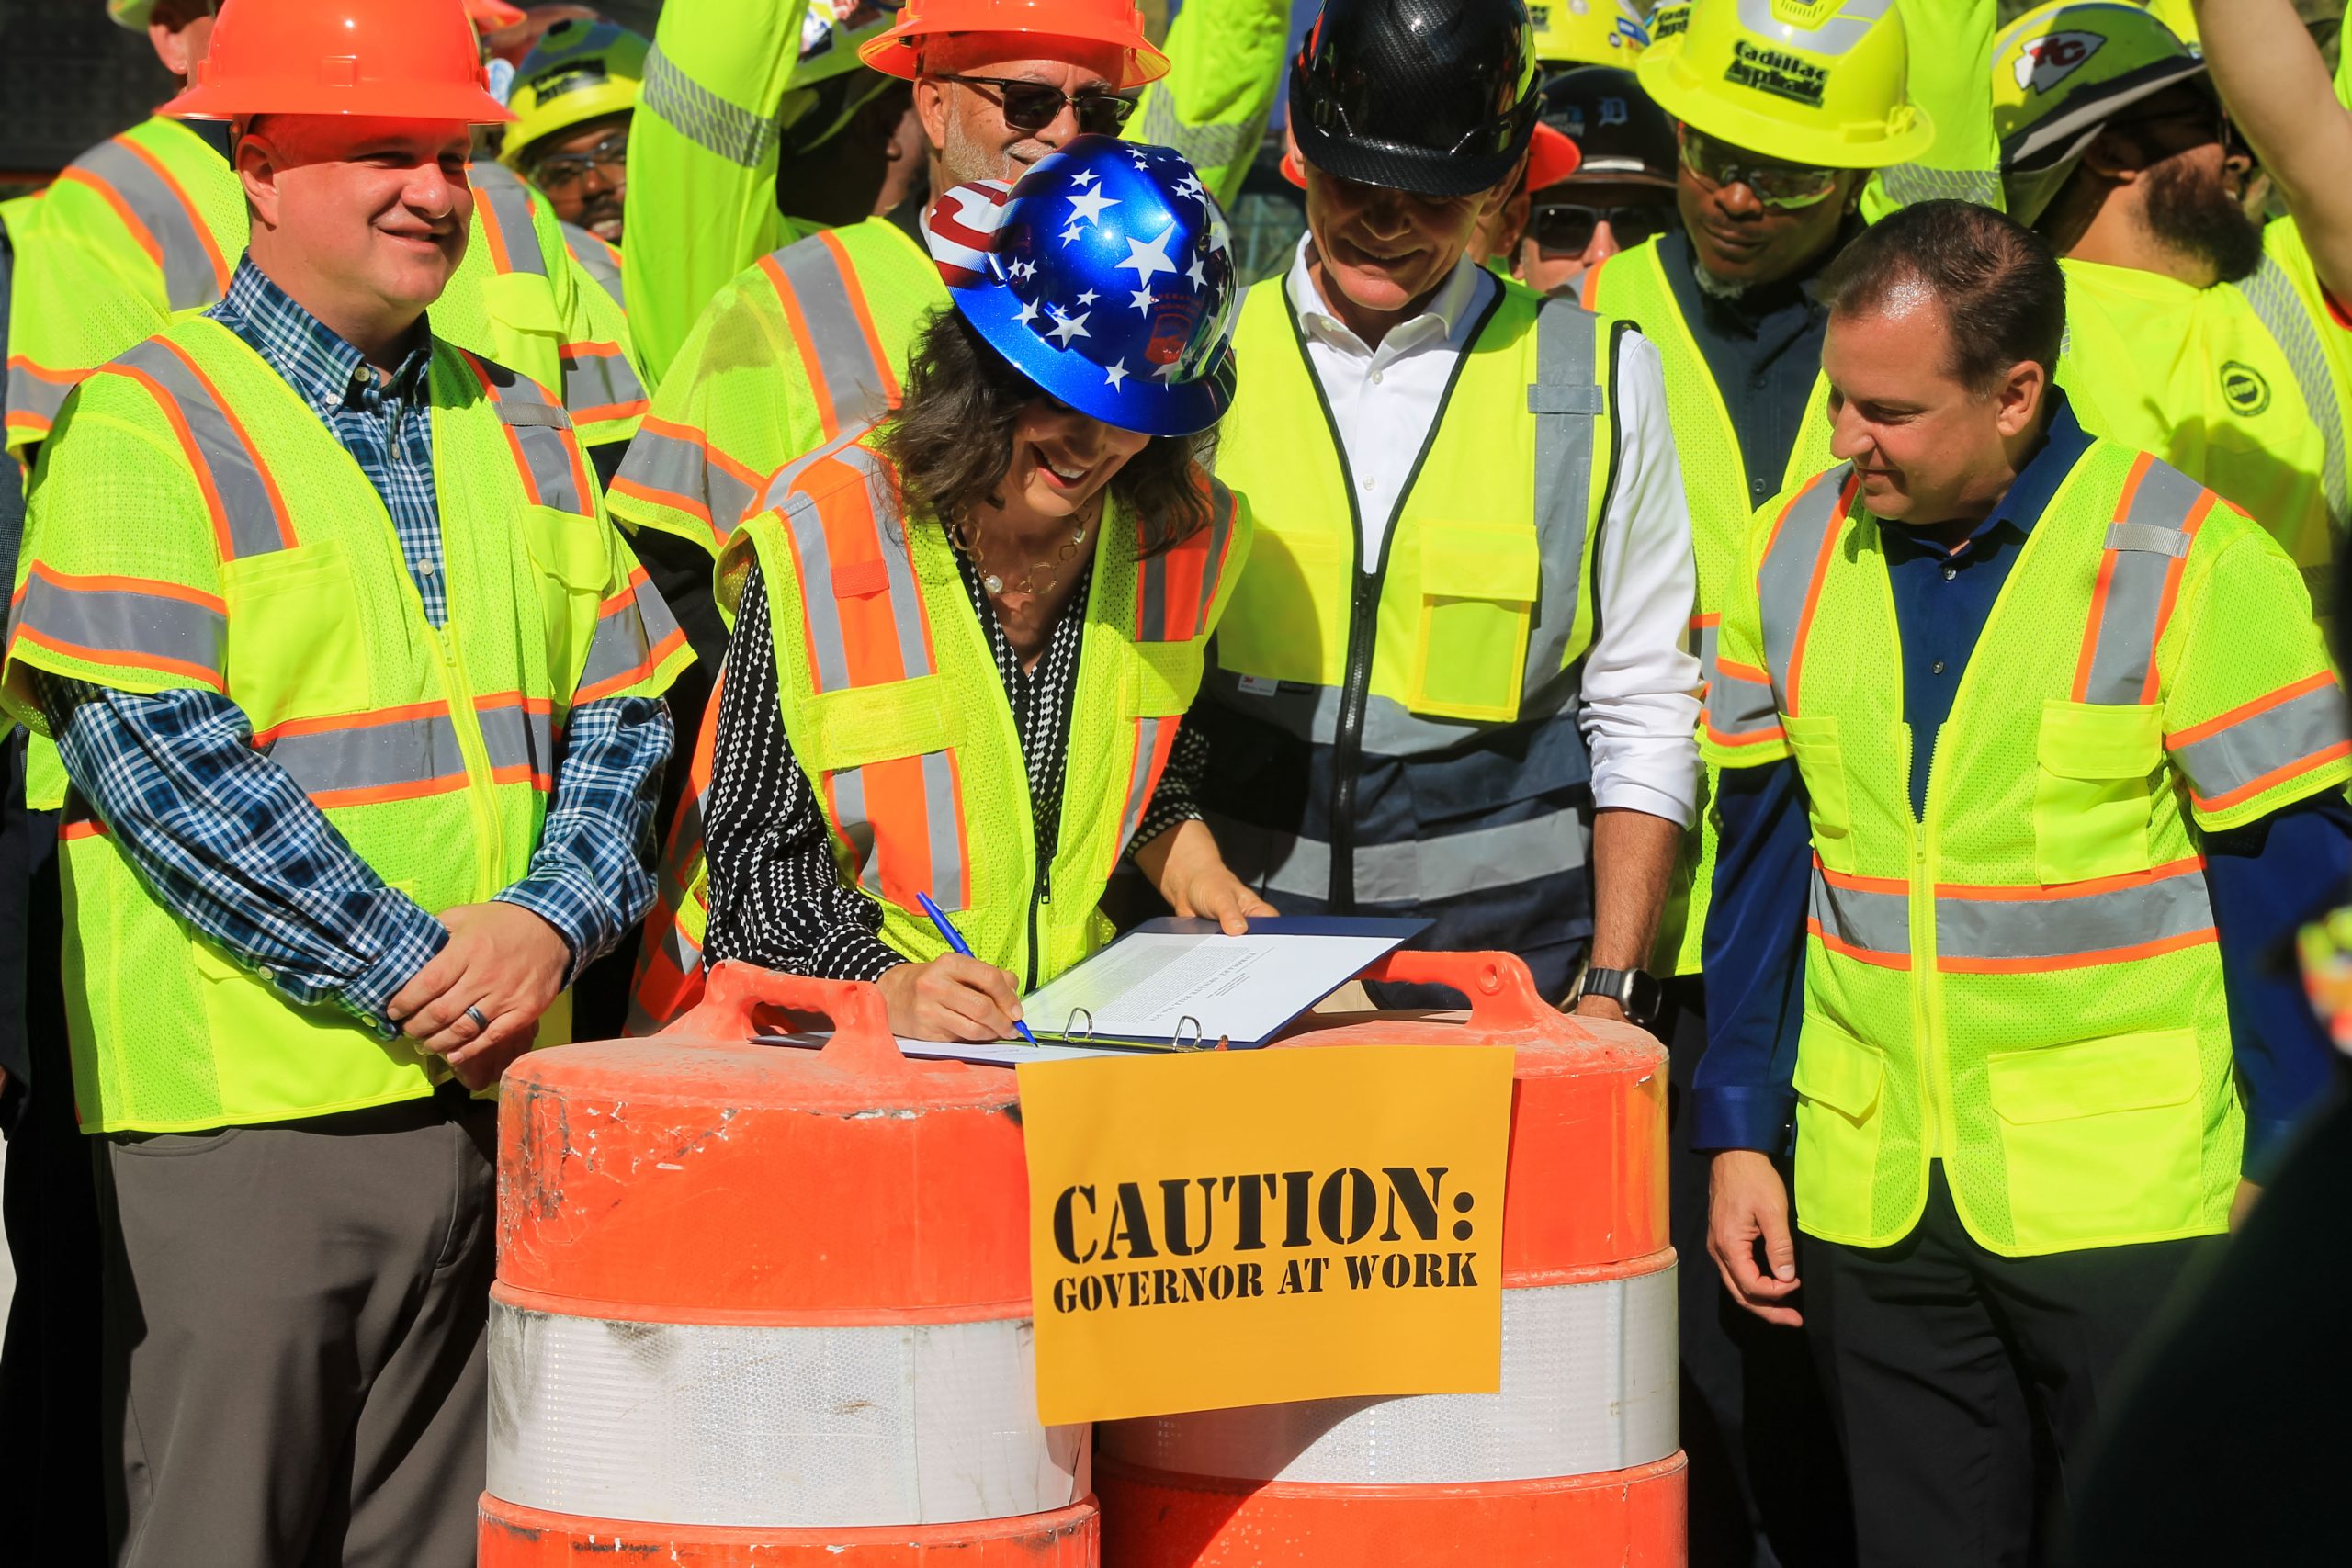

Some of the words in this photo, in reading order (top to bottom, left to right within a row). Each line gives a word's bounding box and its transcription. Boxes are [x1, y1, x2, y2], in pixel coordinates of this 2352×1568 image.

[1735, 40, 1830, 84] Cadillac
[1053, 1167, 1475, 1265] CAUTION:
[1053, 1262, 1264, 1314] GOVERNOR
[1278, 1257, 1329, 1295] AT
[1345, 1252, 1478, 1290] WORK
